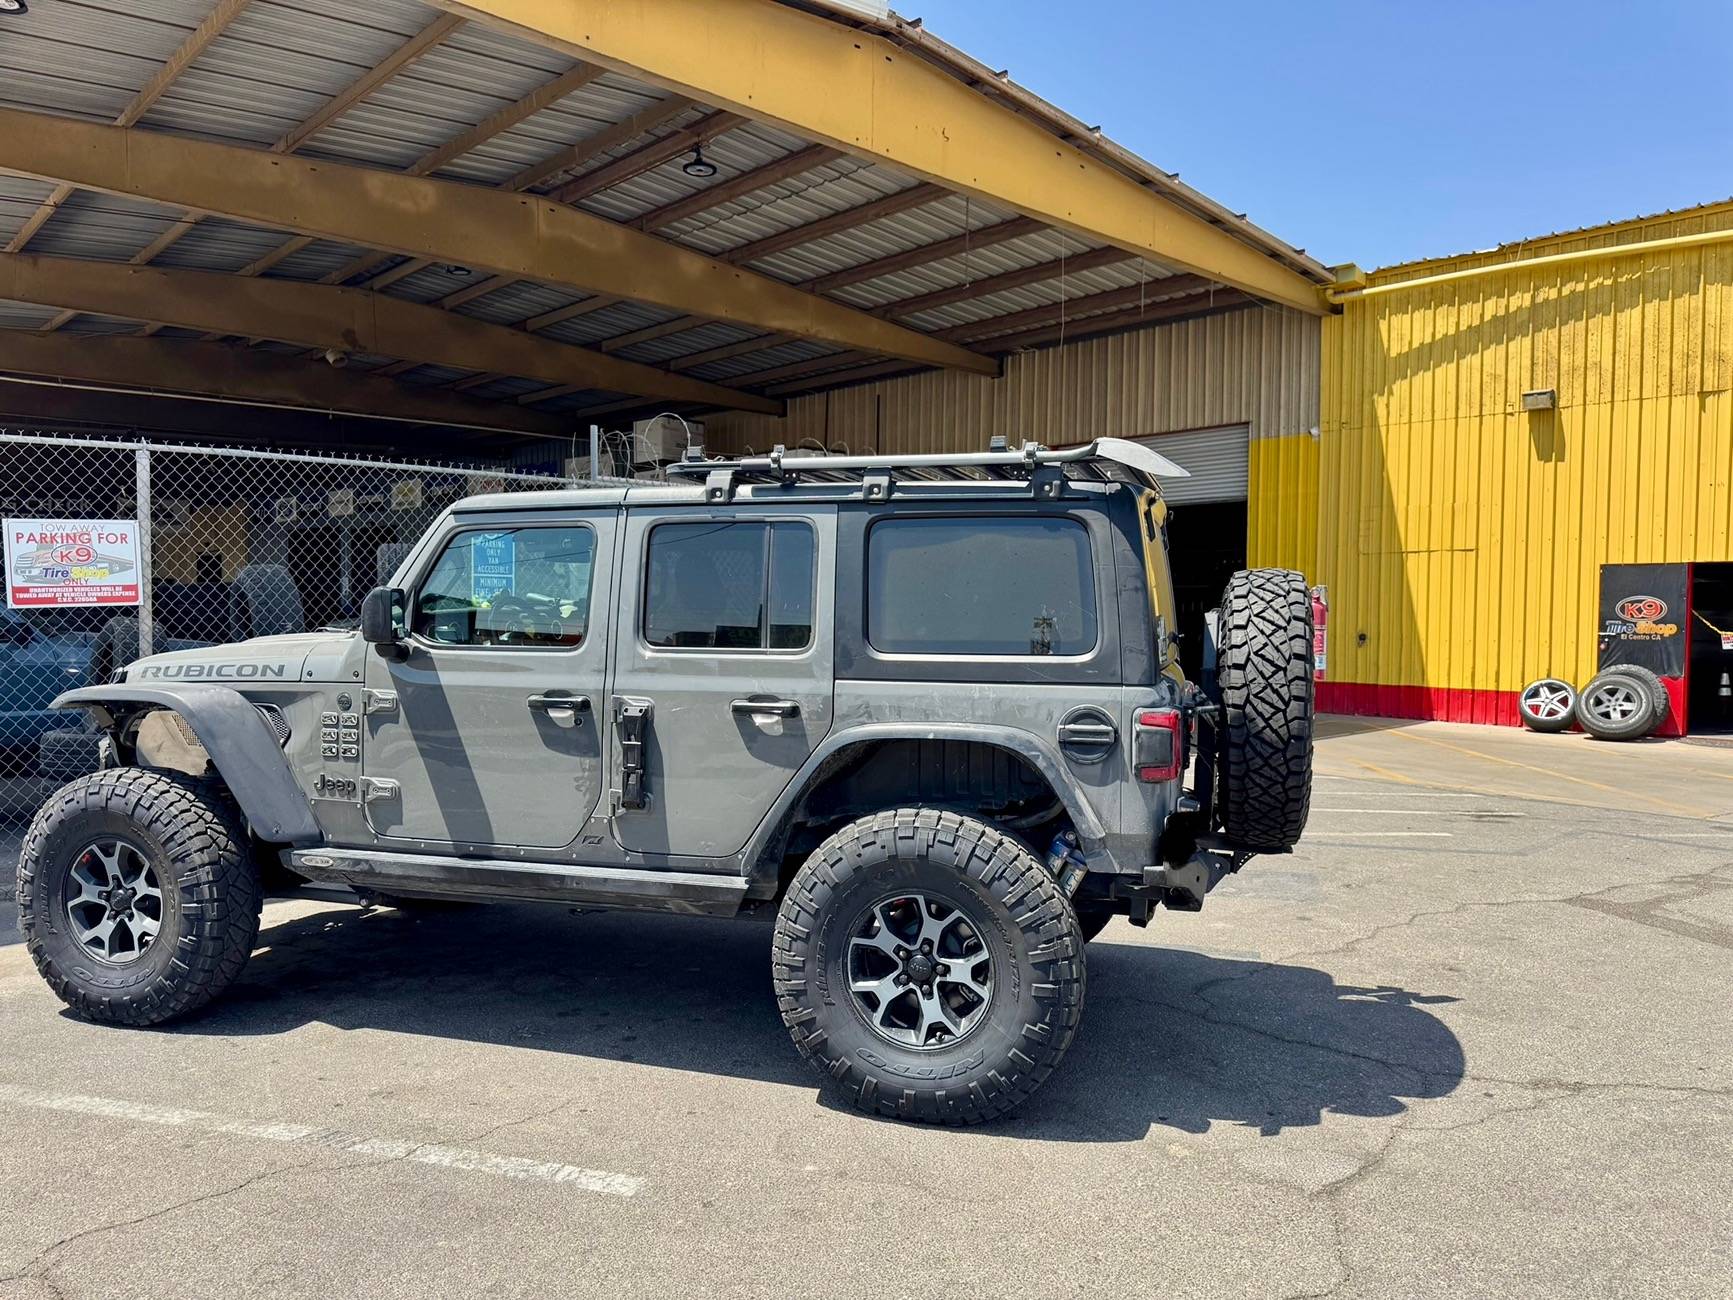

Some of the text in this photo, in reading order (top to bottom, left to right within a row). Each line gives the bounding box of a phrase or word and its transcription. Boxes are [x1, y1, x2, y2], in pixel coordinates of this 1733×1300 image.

[40, 523, 105, 532] TOW AWAY
[16, 532, 128, 544] PARKING FOR
[59, 547, 92, 562] K9
[42, 567, 69, 578] Tire
[1624, 599, 1661, 619] K9
[1606, 620, 1678, 636] Tire Shop
[140, 664, 286, 679] RUBICON
[314, 773, 356, 795] Jeep
